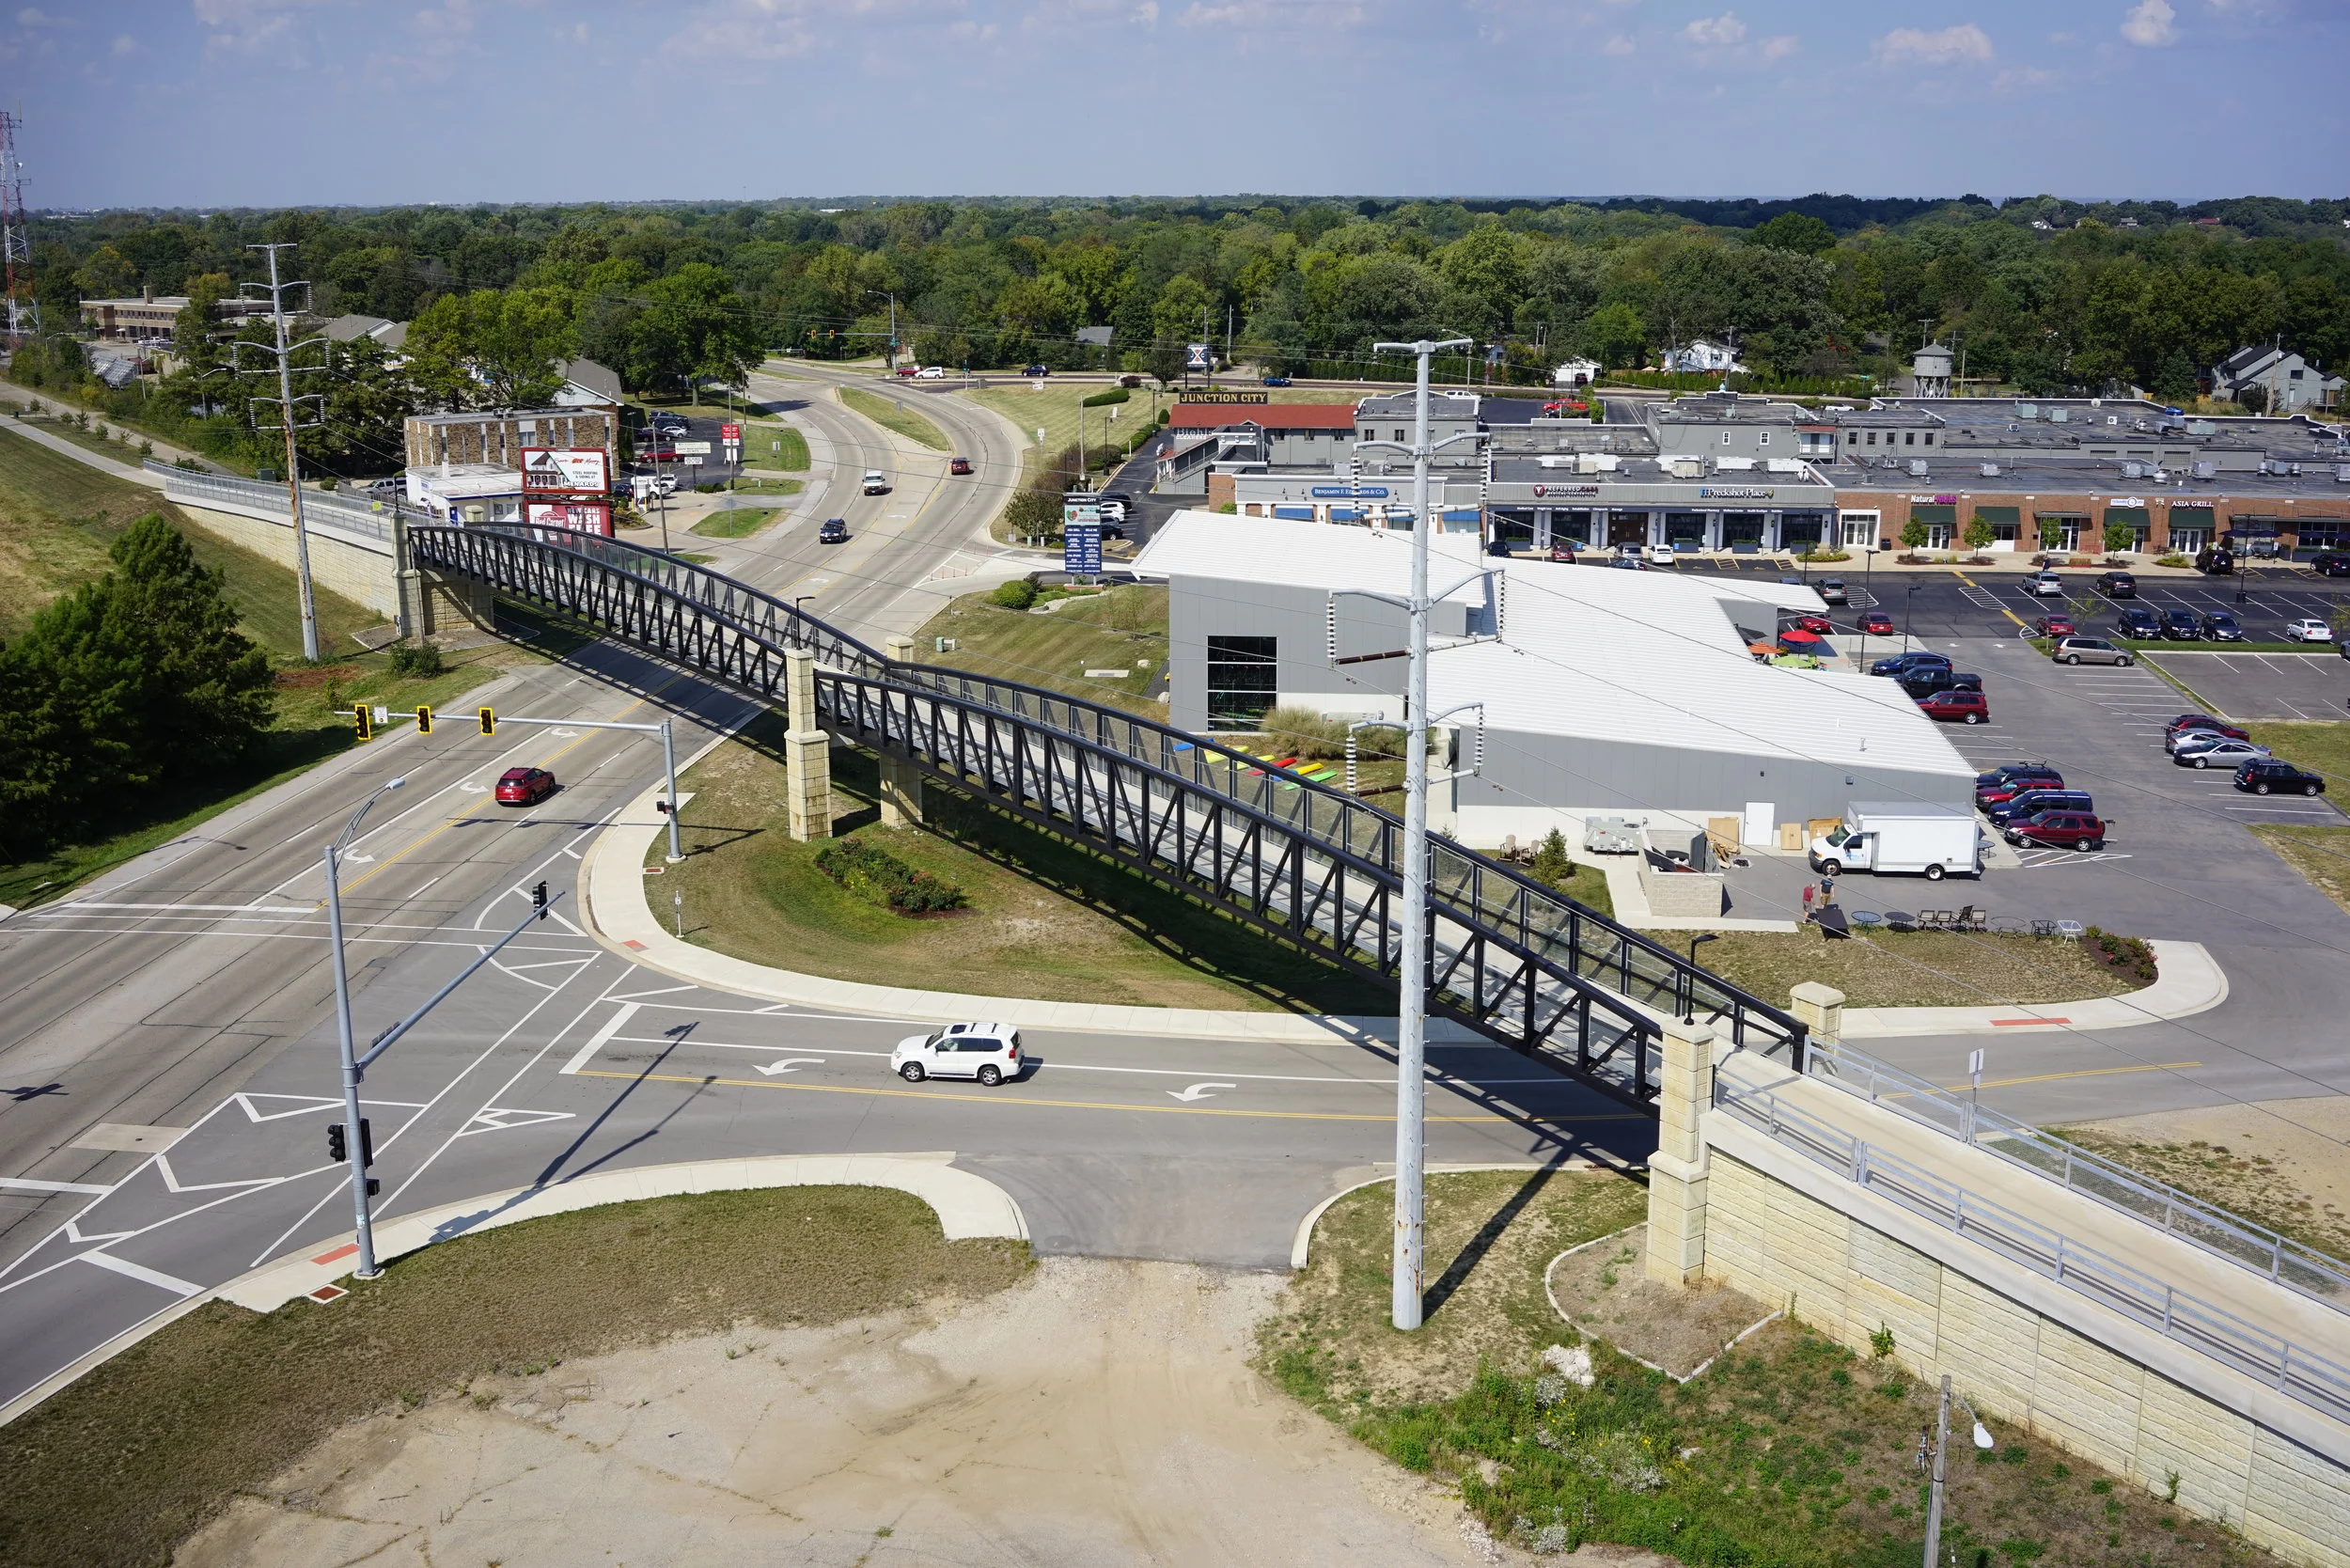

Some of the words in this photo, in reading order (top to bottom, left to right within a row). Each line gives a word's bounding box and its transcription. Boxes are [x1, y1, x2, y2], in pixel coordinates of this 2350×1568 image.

[1181, 393, 1238, 402] JUNCTION
[1241, 393, 1266, 402] CITY
[1746, 488, 1765, 496] Place
